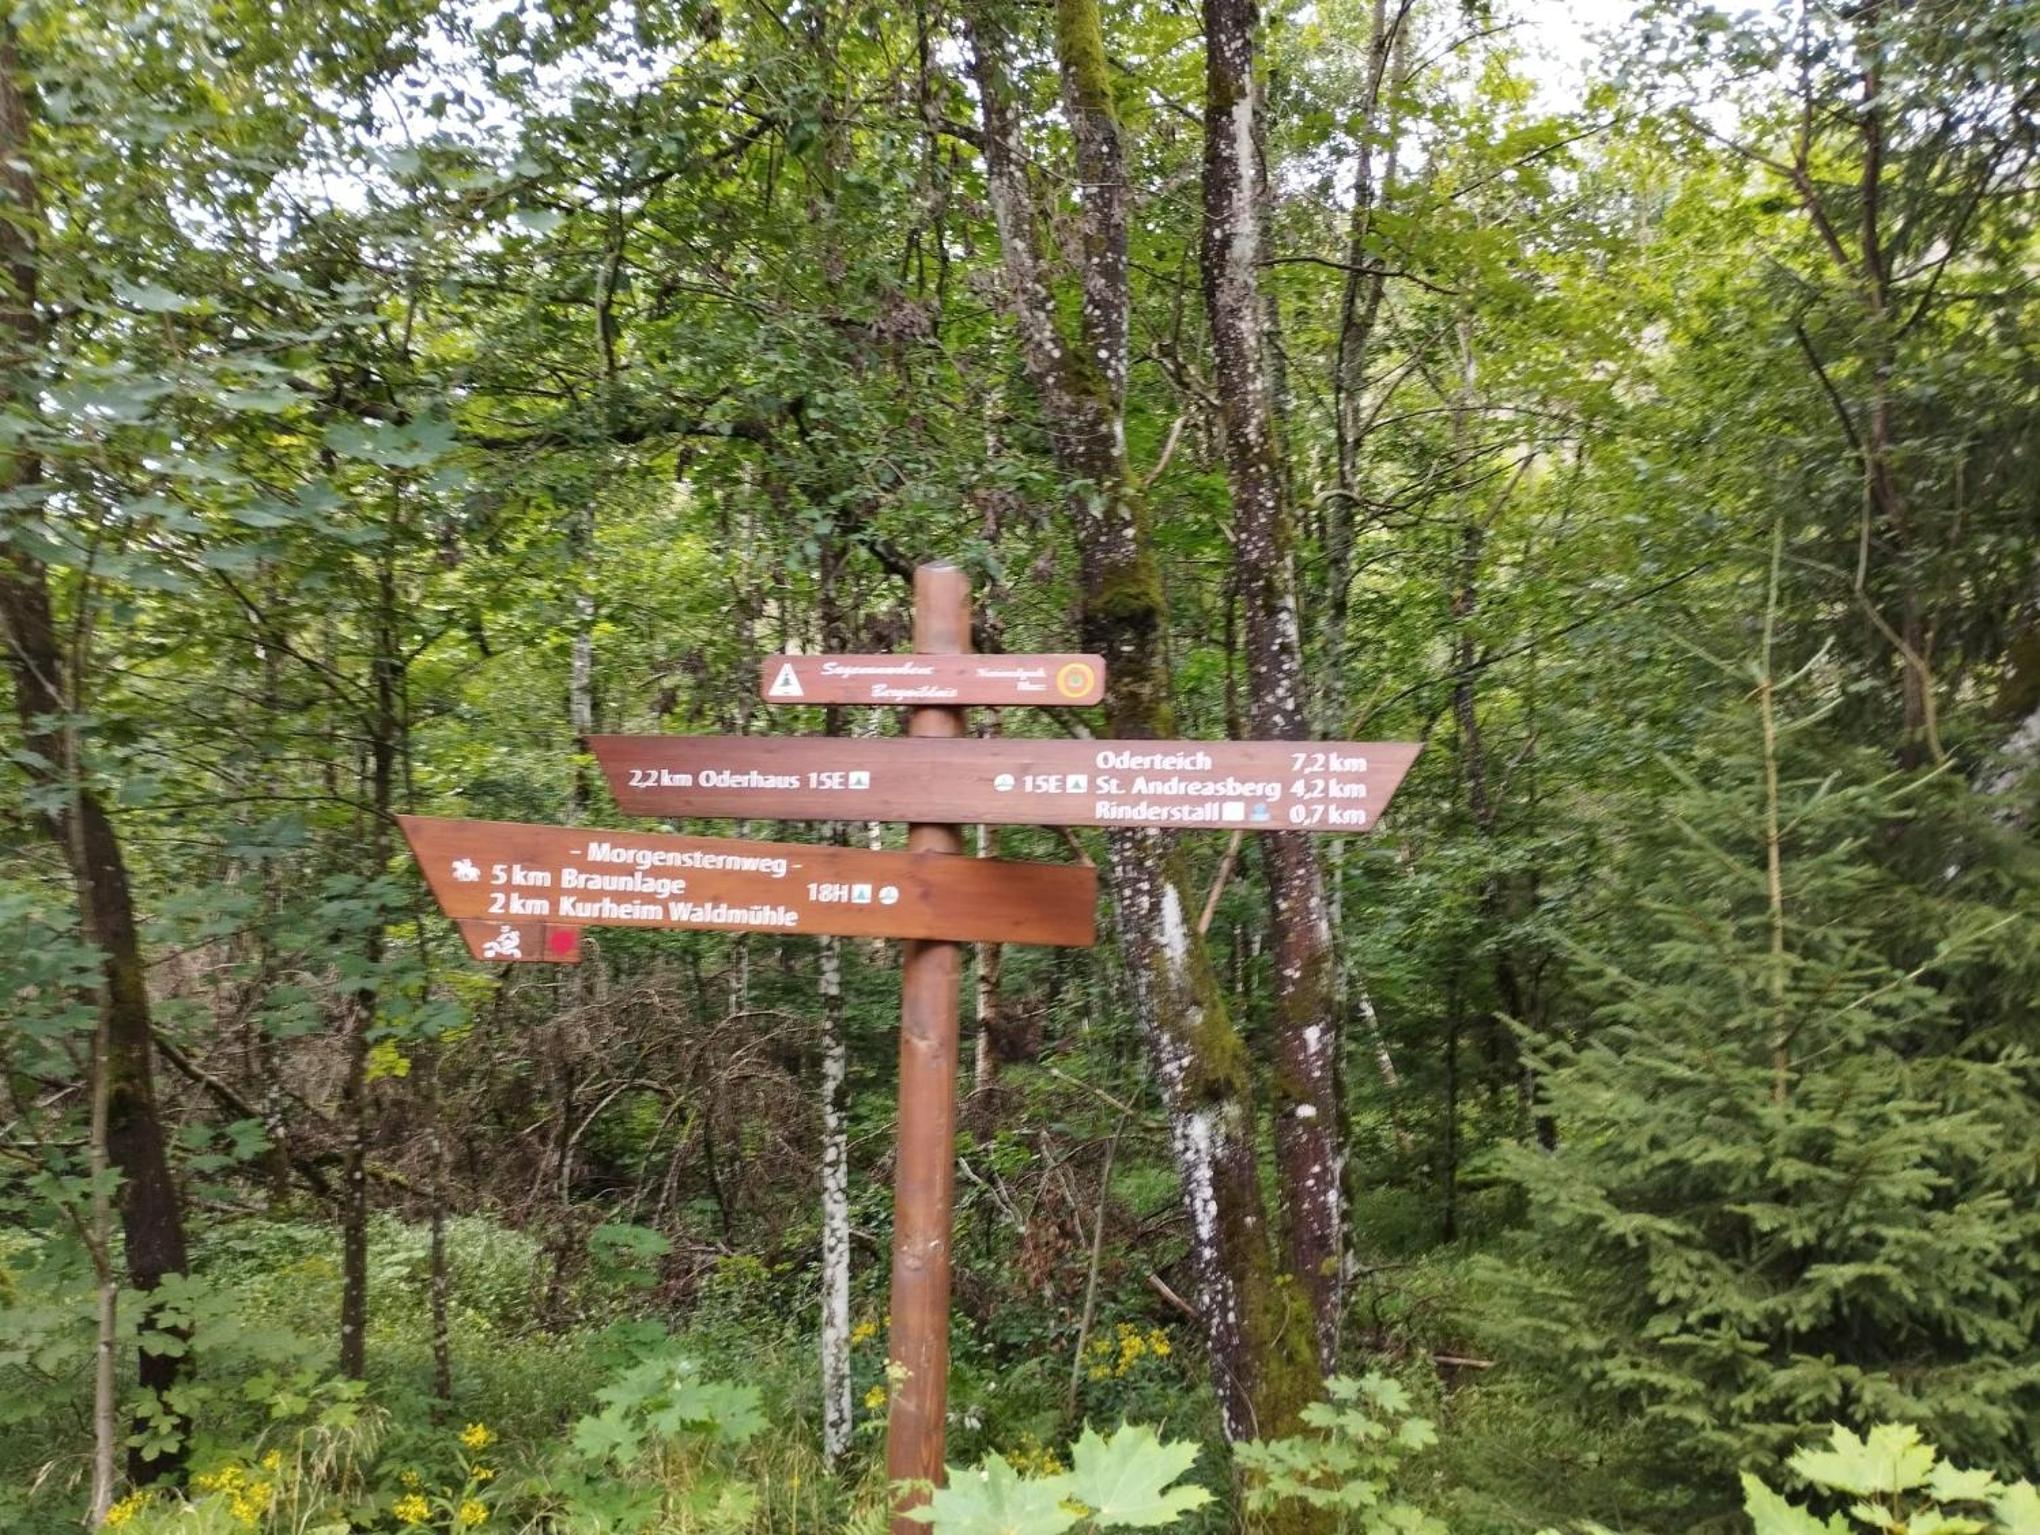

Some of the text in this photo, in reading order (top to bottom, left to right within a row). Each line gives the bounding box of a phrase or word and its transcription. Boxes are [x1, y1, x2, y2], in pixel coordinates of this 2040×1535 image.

[1095, 750, 1368, 775] Oderteich 7,2 km
[698, 769, 801, 790] Oderhaus
[1095, 775, 1127, 796] St.
[1131, 776, 1282, 801] Andreasberg
[1289, 778, 1326, 800] 4,2
[1328, 777, 1367, 799] km
[1095, 801, 1366, 826] Rinderstall 0,7 km
[586, 841, 787, 878] Morgensternweg
[491, 865, 686, 897] 5 km Braunlage
[488, 893, 799, 927] 2 km Kurheim Waldmühle
